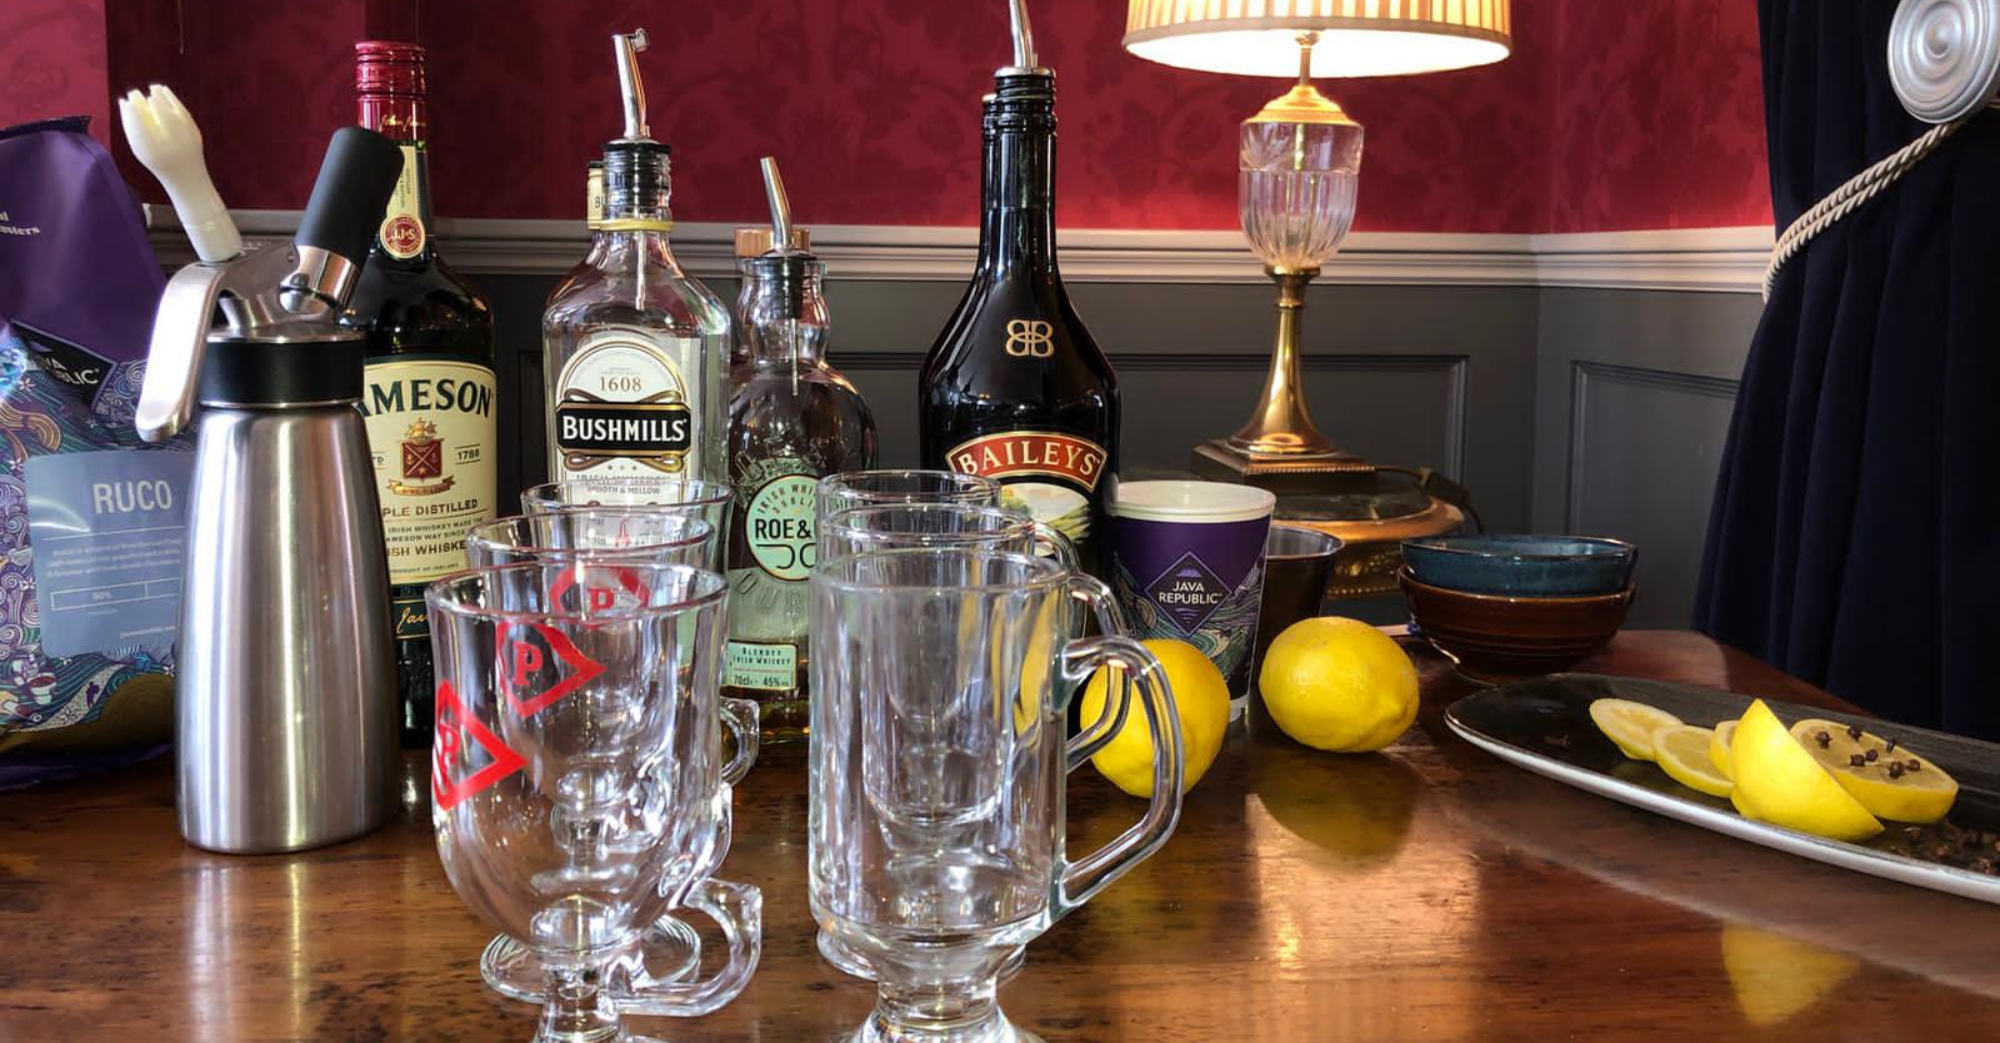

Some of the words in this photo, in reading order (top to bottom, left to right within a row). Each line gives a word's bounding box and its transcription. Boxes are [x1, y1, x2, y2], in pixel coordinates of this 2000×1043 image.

[600, 376, 643, 392] 1608
[562, 415, 686, 441] BUSHMILLS
[958, 440, 1100, 475] BAILEYS
[92, 479, 173, 515] RUCO
[628, 486, 661, 495] MELLOW
[382, 506, 411, 517] PLE
[415, 498, 478, 516] DISTILLED
[414, 522, 452, 532] WHISKEY
[424, 533, 443, 541] WAY
[414, 540, 467, 555] WHISKE
[1172, 581, 1205, 592] JAVA
[1159, 592, 1219, 604] REPUBLIC
[512, 641, 544, 687] P
